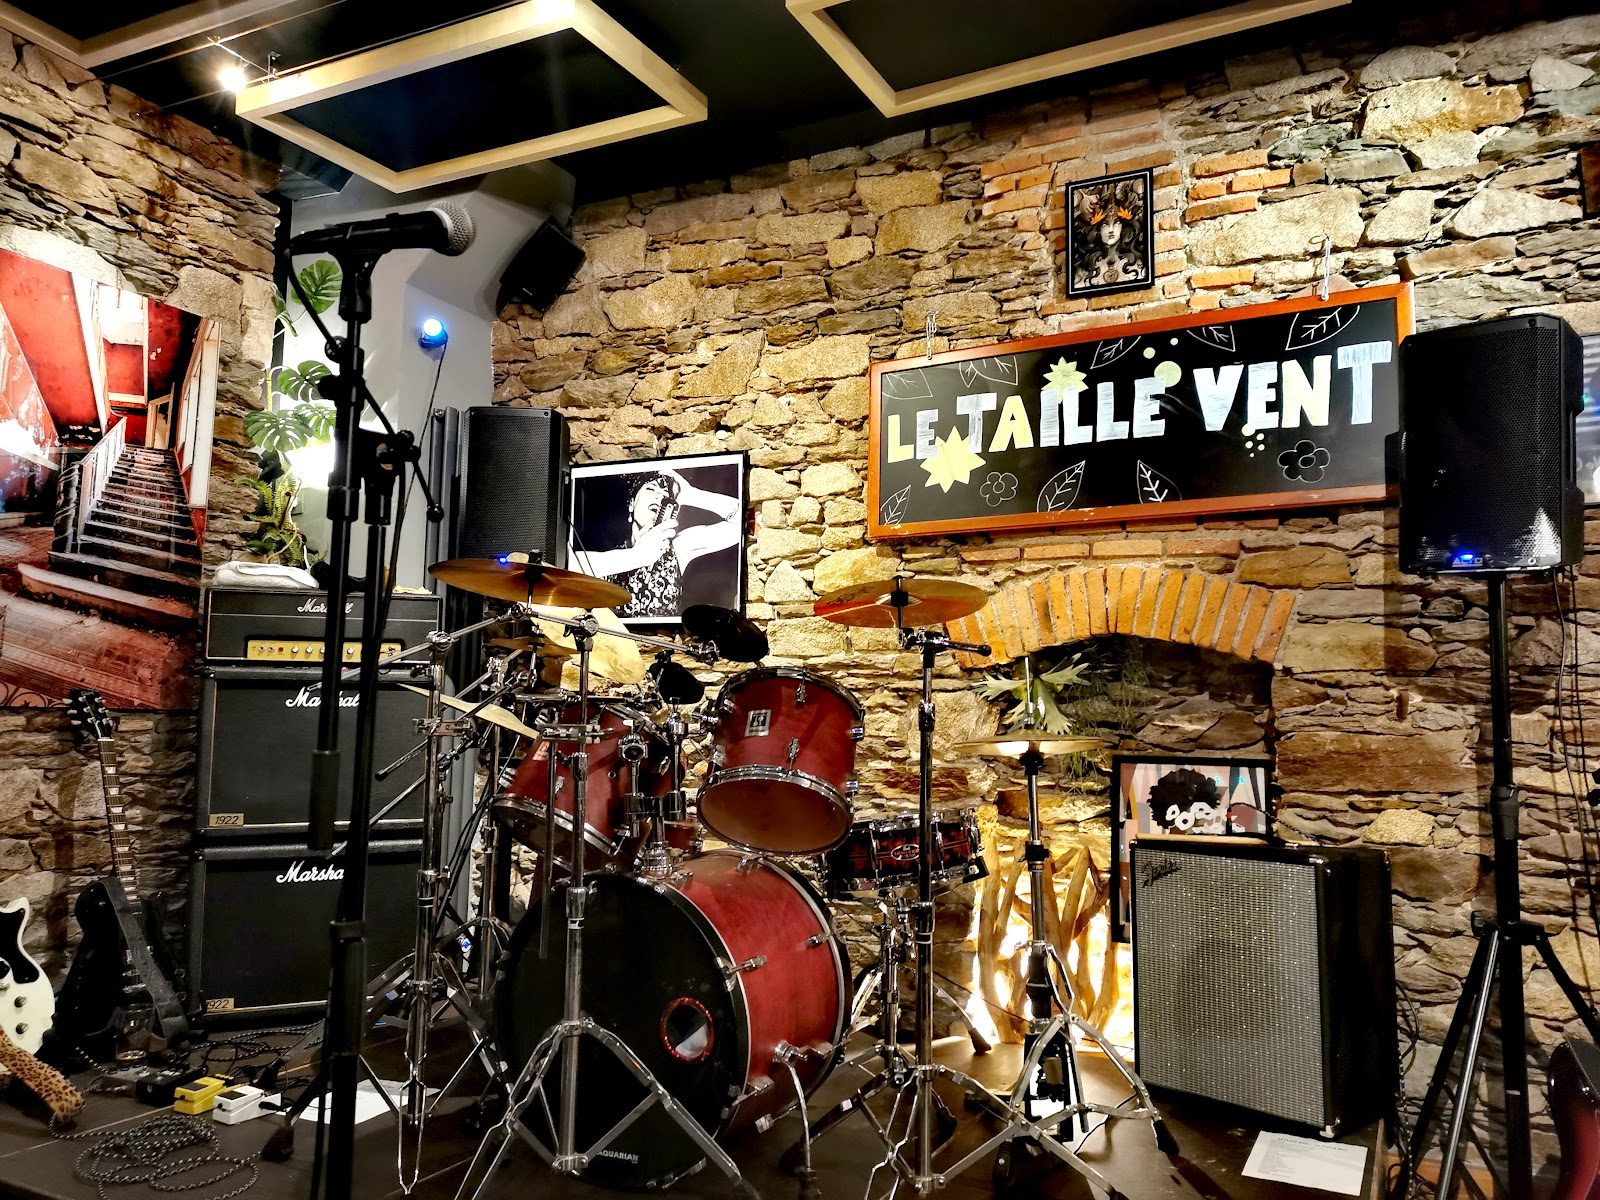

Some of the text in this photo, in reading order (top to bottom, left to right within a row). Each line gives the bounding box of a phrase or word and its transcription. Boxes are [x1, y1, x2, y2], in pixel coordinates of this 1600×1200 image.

[888, 341, 1393, 463] LE TAILLE VENT
[215, 815, 239, 825] 1922
[276, 860, 345, 883] Marsha
